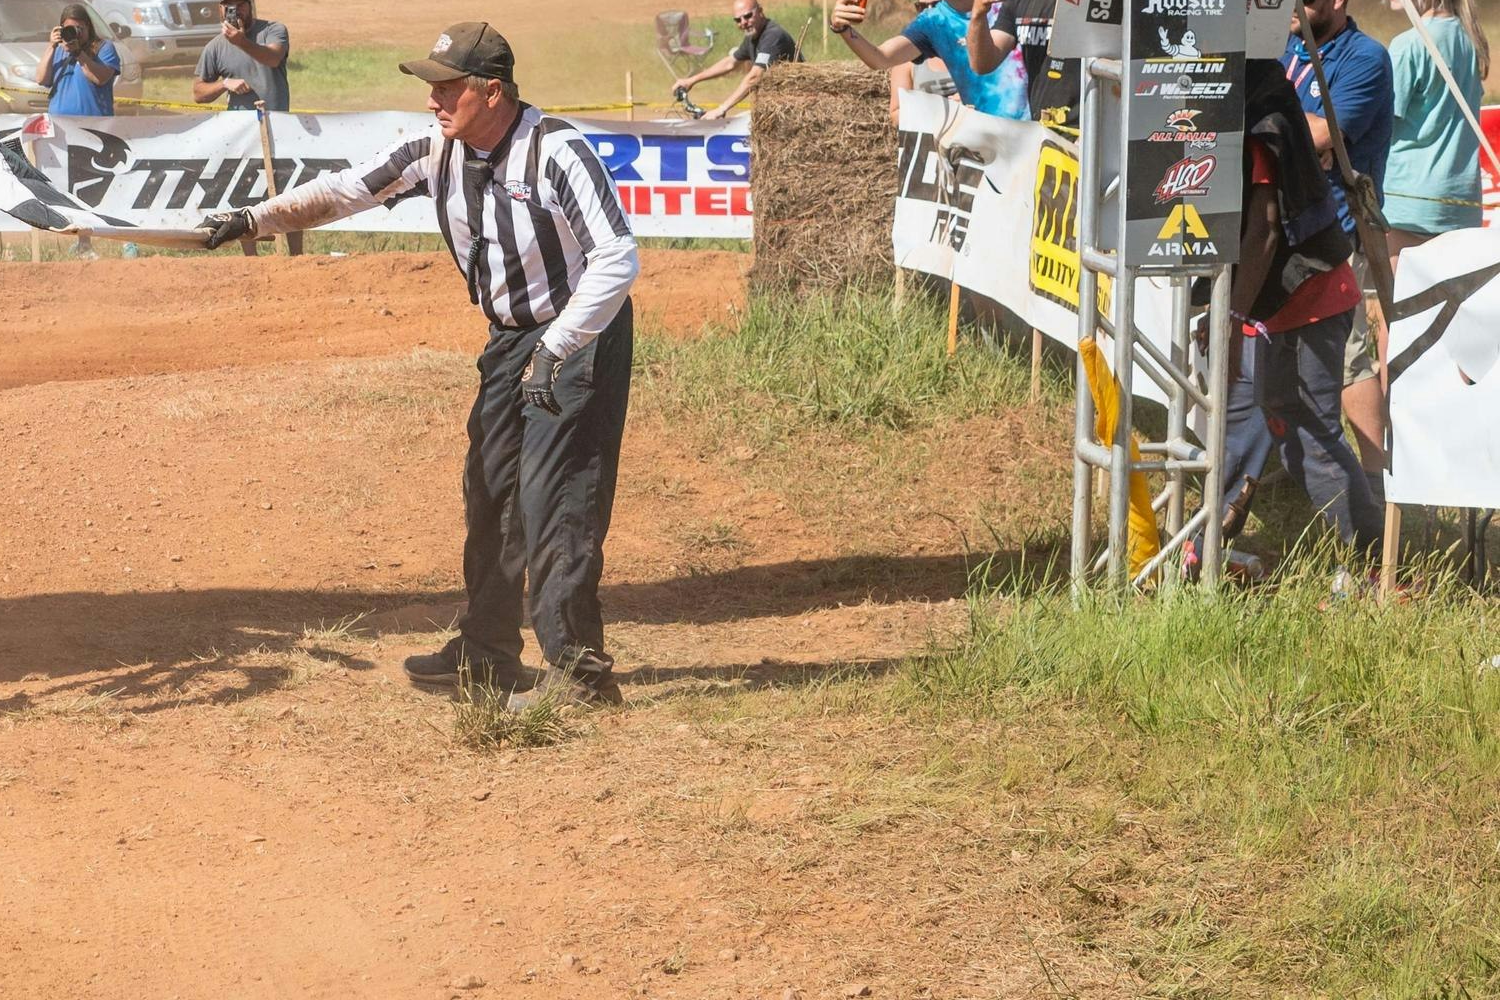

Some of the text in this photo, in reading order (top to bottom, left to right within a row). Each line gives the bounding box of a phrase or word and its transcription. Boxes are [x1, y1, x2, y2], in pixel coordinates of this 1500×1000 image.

[1141, 63, 1224, 74] MICHELIN
[1147, 131, 1217, 142] ALL BALLS
[1148, 242, 1218, 256] ARMA
